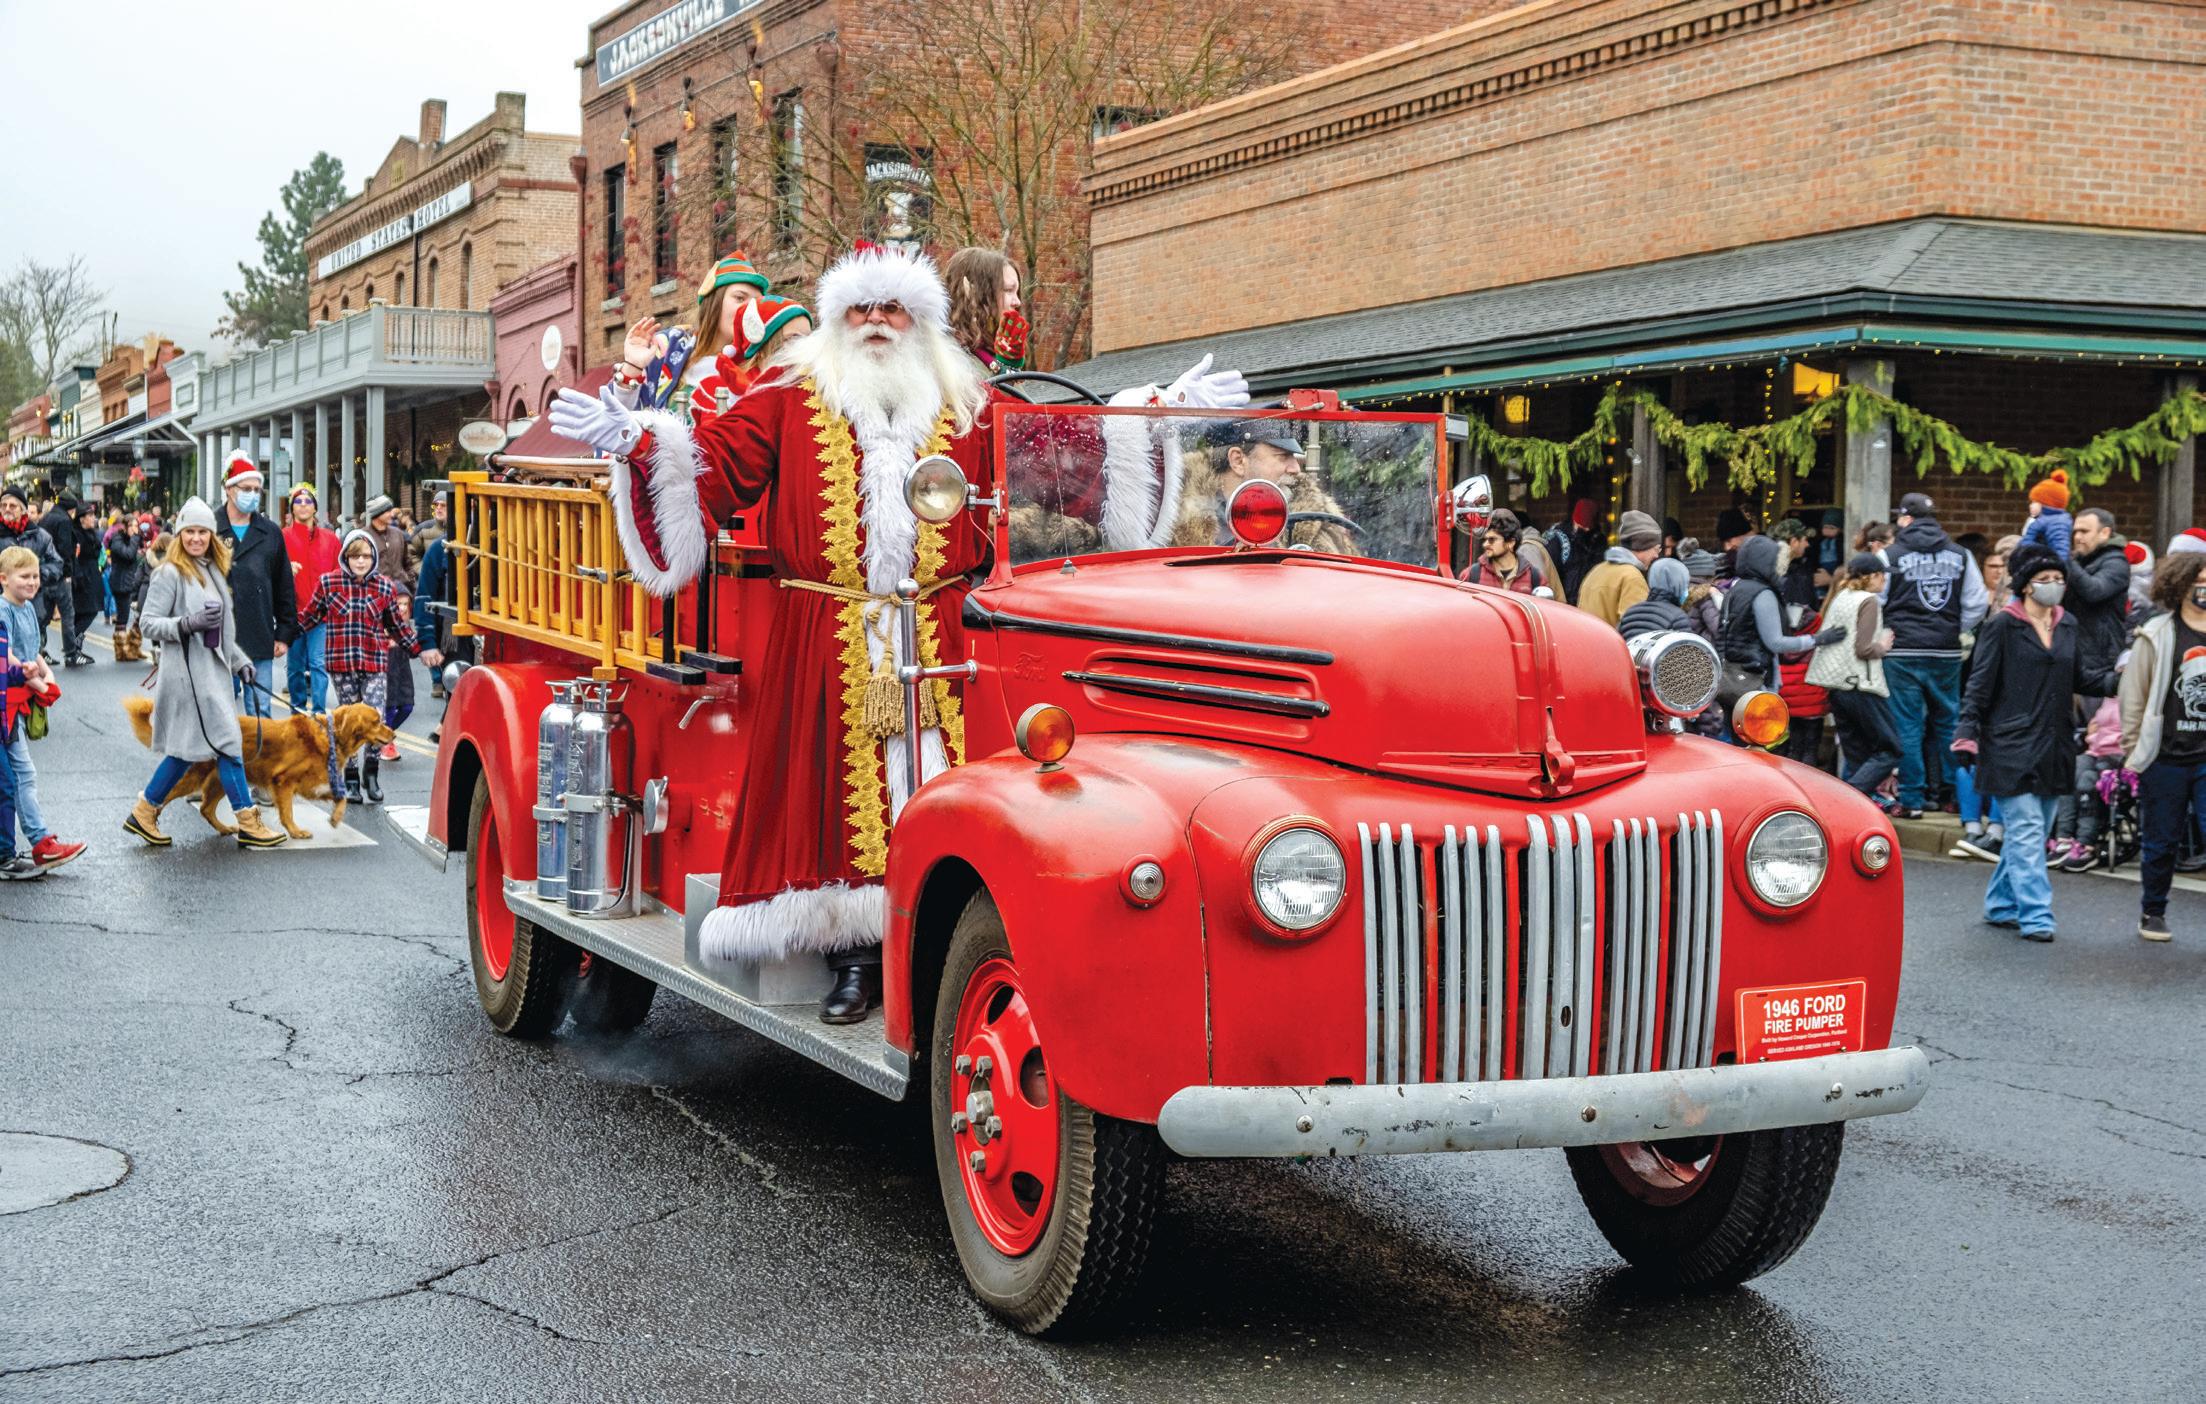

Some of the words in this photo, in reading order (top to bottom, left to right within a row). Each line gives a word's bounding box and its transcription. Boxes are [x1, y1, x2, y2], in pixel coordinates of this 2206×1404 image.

[608, 0, 725, 75] JACKSONVILLE
[331, 240, 361, 270] UNITED
[371, 220, 407, 251] STATES
[417, 194, 450, 228] HOTEL
[1763, 998, 1800, 1019] 1946
[1804, 994, 1846, 1015] FORD
[1764, 1018, 1793, 1035] FIRE
[1795, 1013, 1844, 1032] PUMPER
